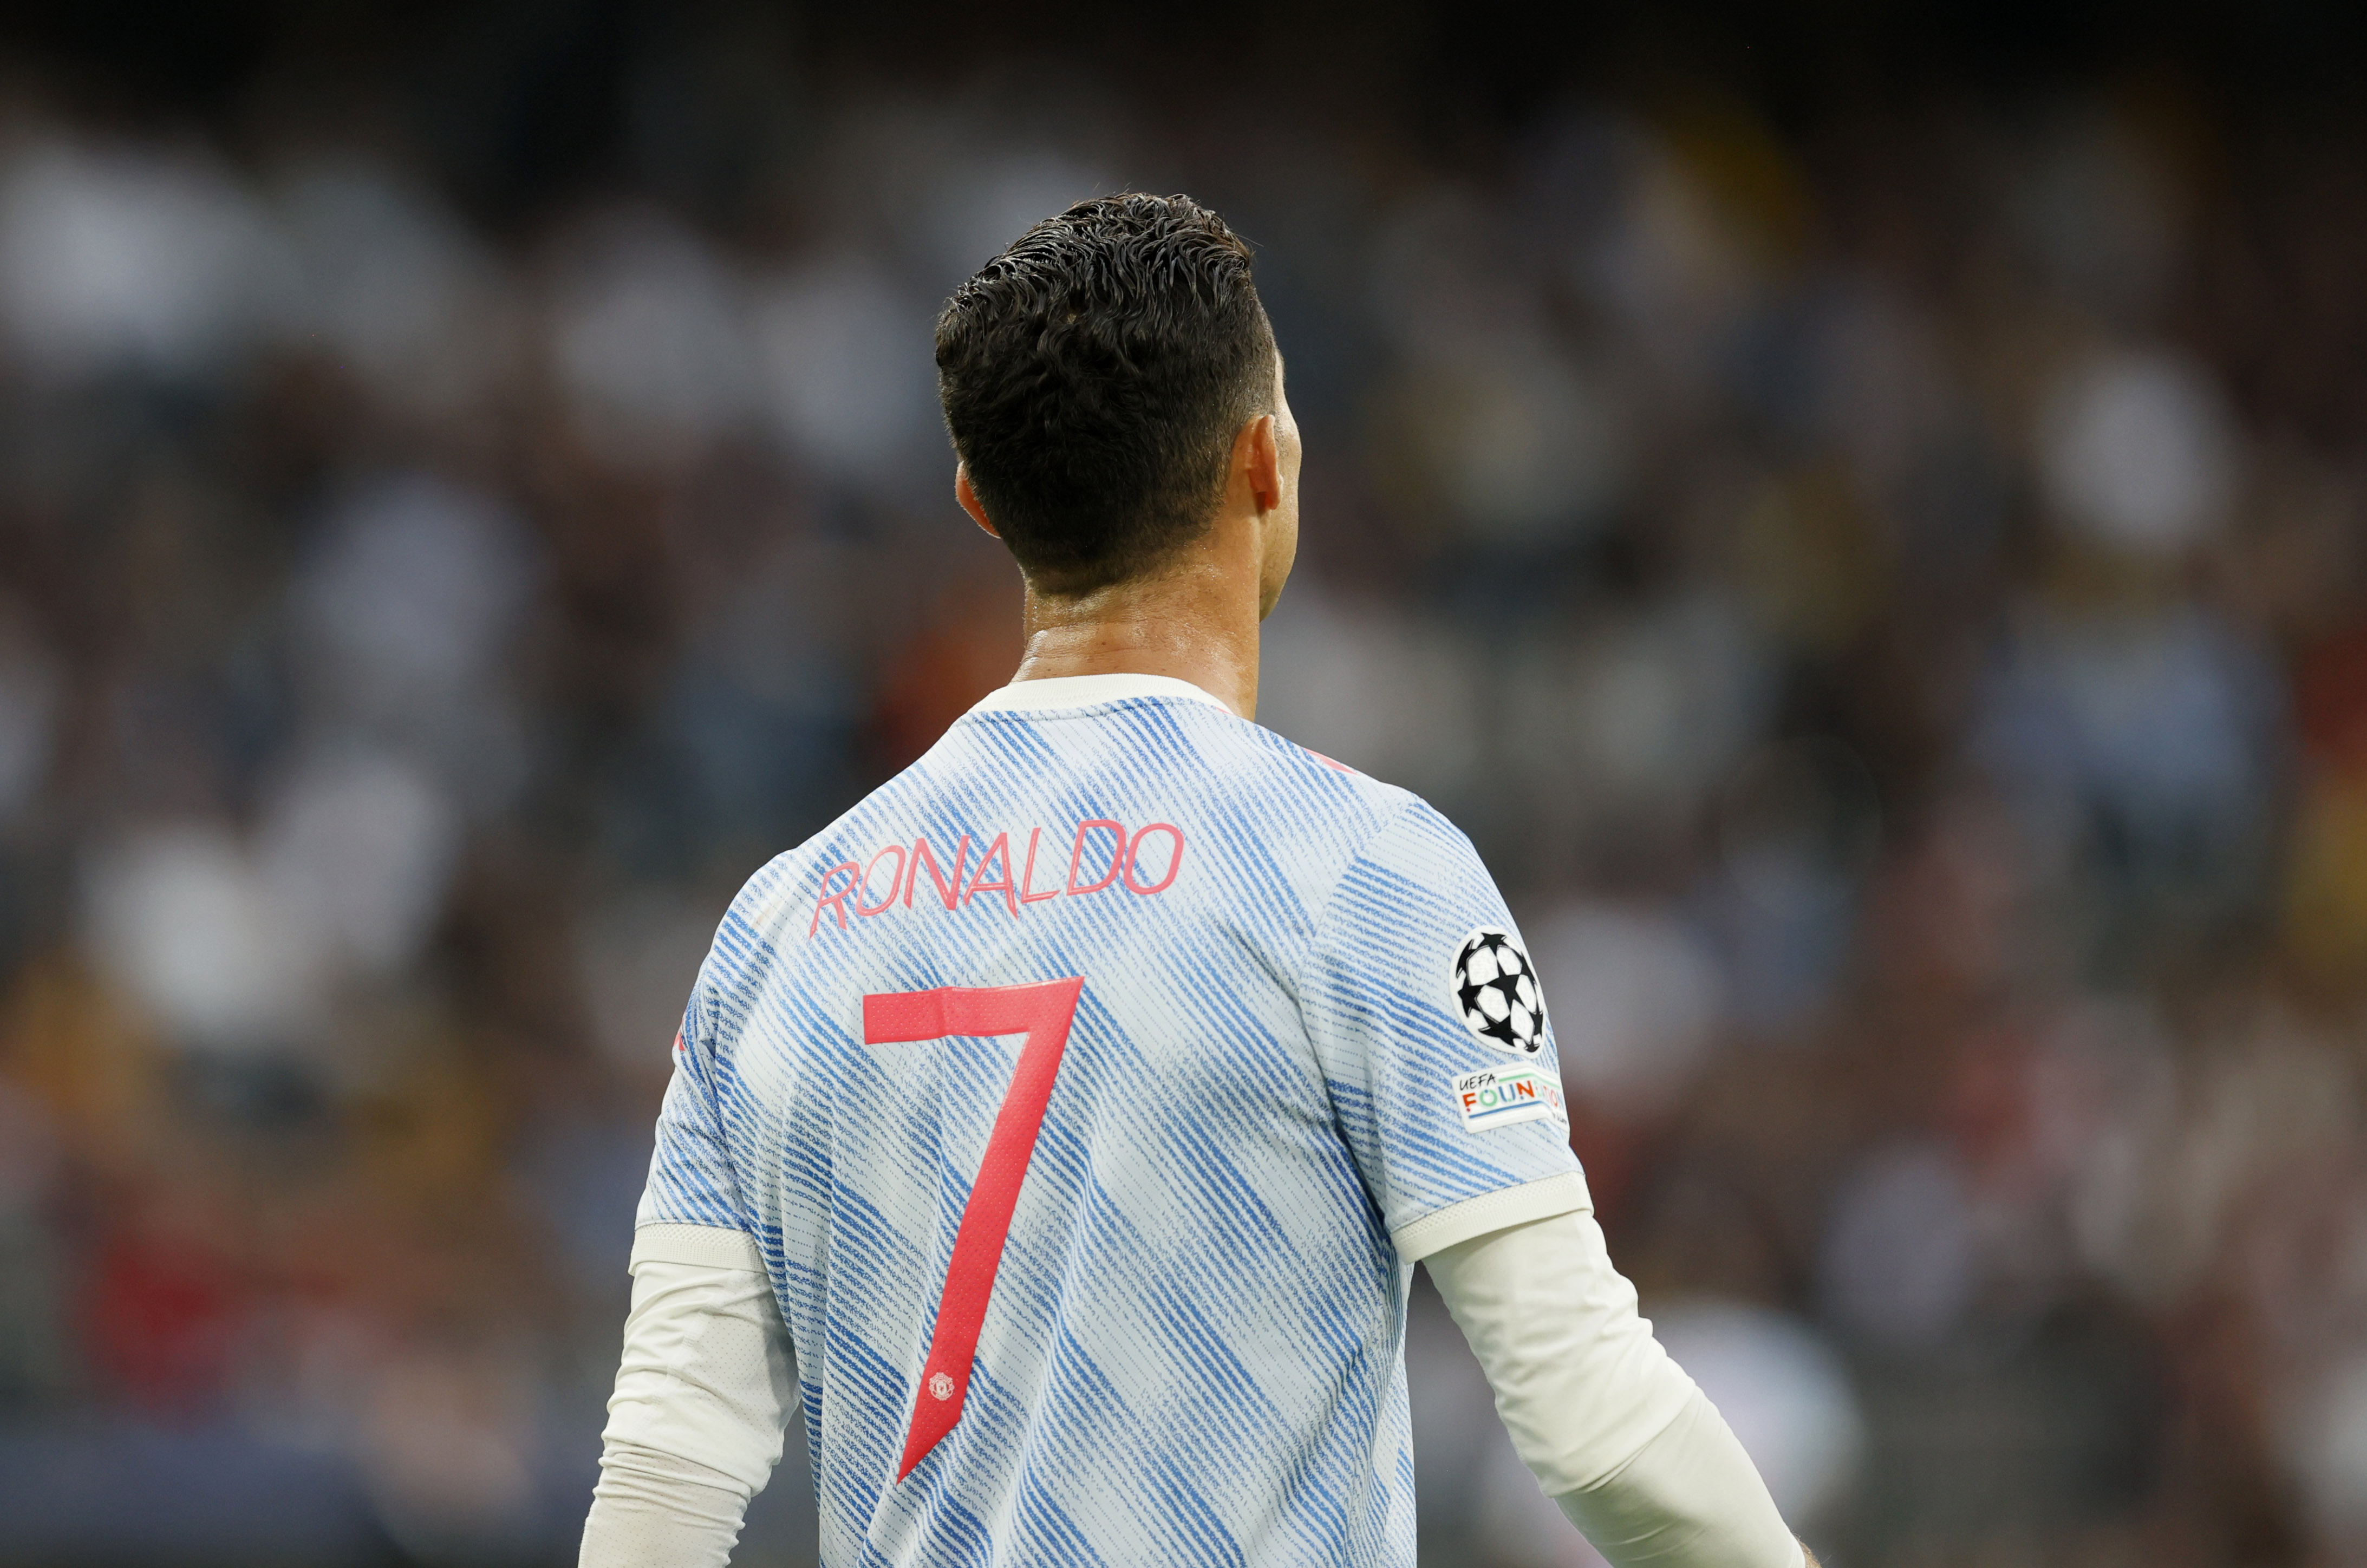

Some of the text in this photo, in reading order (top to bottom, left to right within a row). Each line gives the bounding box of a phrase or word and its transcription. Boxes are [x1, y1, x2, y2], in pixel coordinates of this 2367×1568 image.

[809, 819, 1185, 939] RONALDO
[1459, 1073, 1496, 1091] UEFA
[862, 976, 1085, 1486] 7
